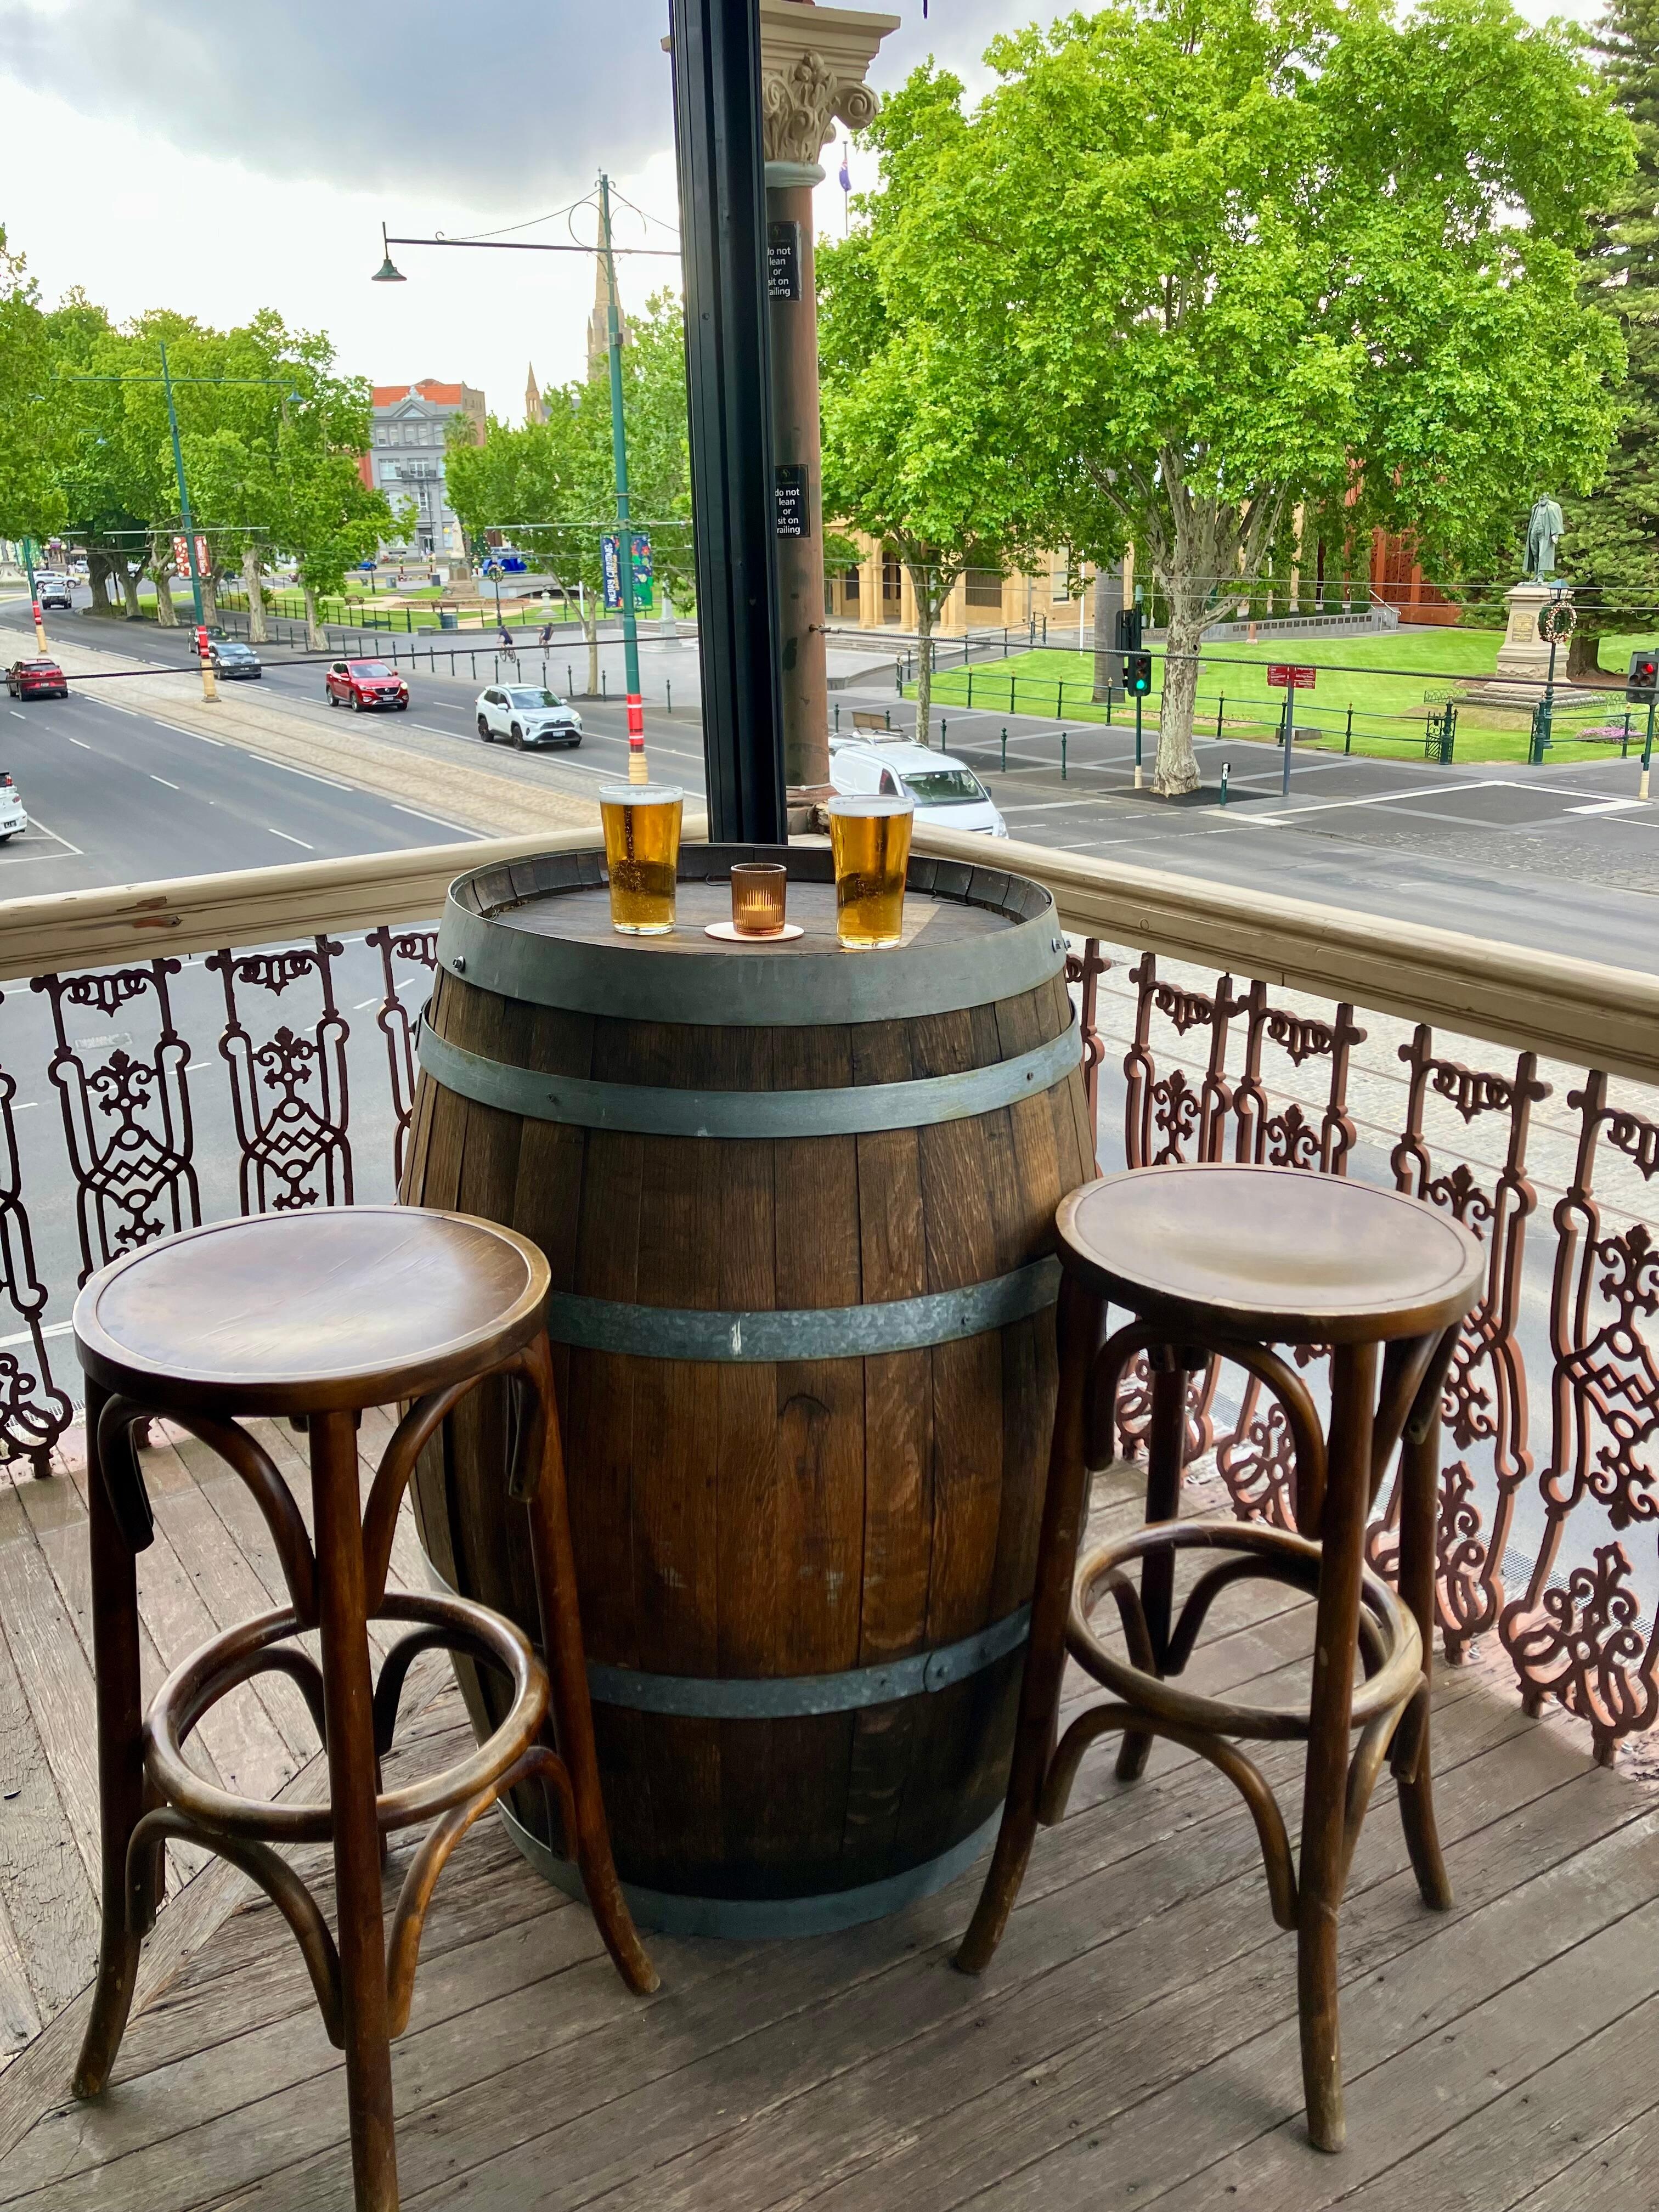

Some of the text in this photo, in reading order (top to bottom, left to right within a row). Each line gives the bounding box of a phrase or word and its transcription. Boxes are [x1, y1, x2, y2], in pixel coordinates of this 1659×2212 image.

[776, 246, 791, 255] not
[769, 257, 786, 266] lean
[768, 277, 776, 286] sit
[775, 488, 800, 496] do not
[779, 498, 795, 506] lean
[777, 516, 786, 524] sit
[777, 526, 801, 535] railing
[607, 579, 617, 602] MERRY
